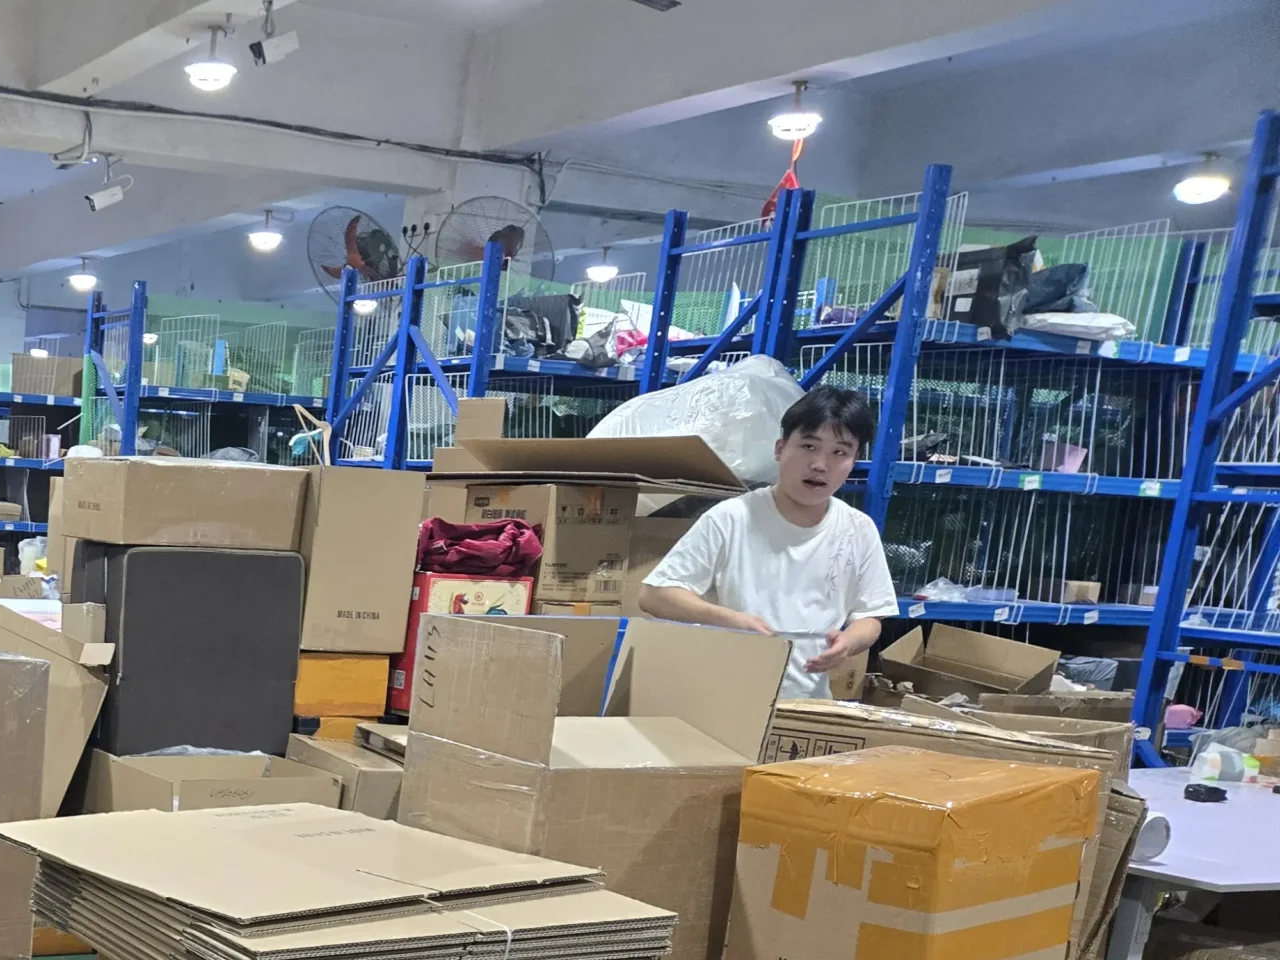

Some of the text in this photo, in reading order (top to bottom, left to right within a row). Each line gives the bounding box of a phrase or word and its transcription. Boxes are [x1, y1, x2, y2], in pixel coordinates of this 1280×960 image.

[337, 609, 380, 620] MADE IN CHINA
